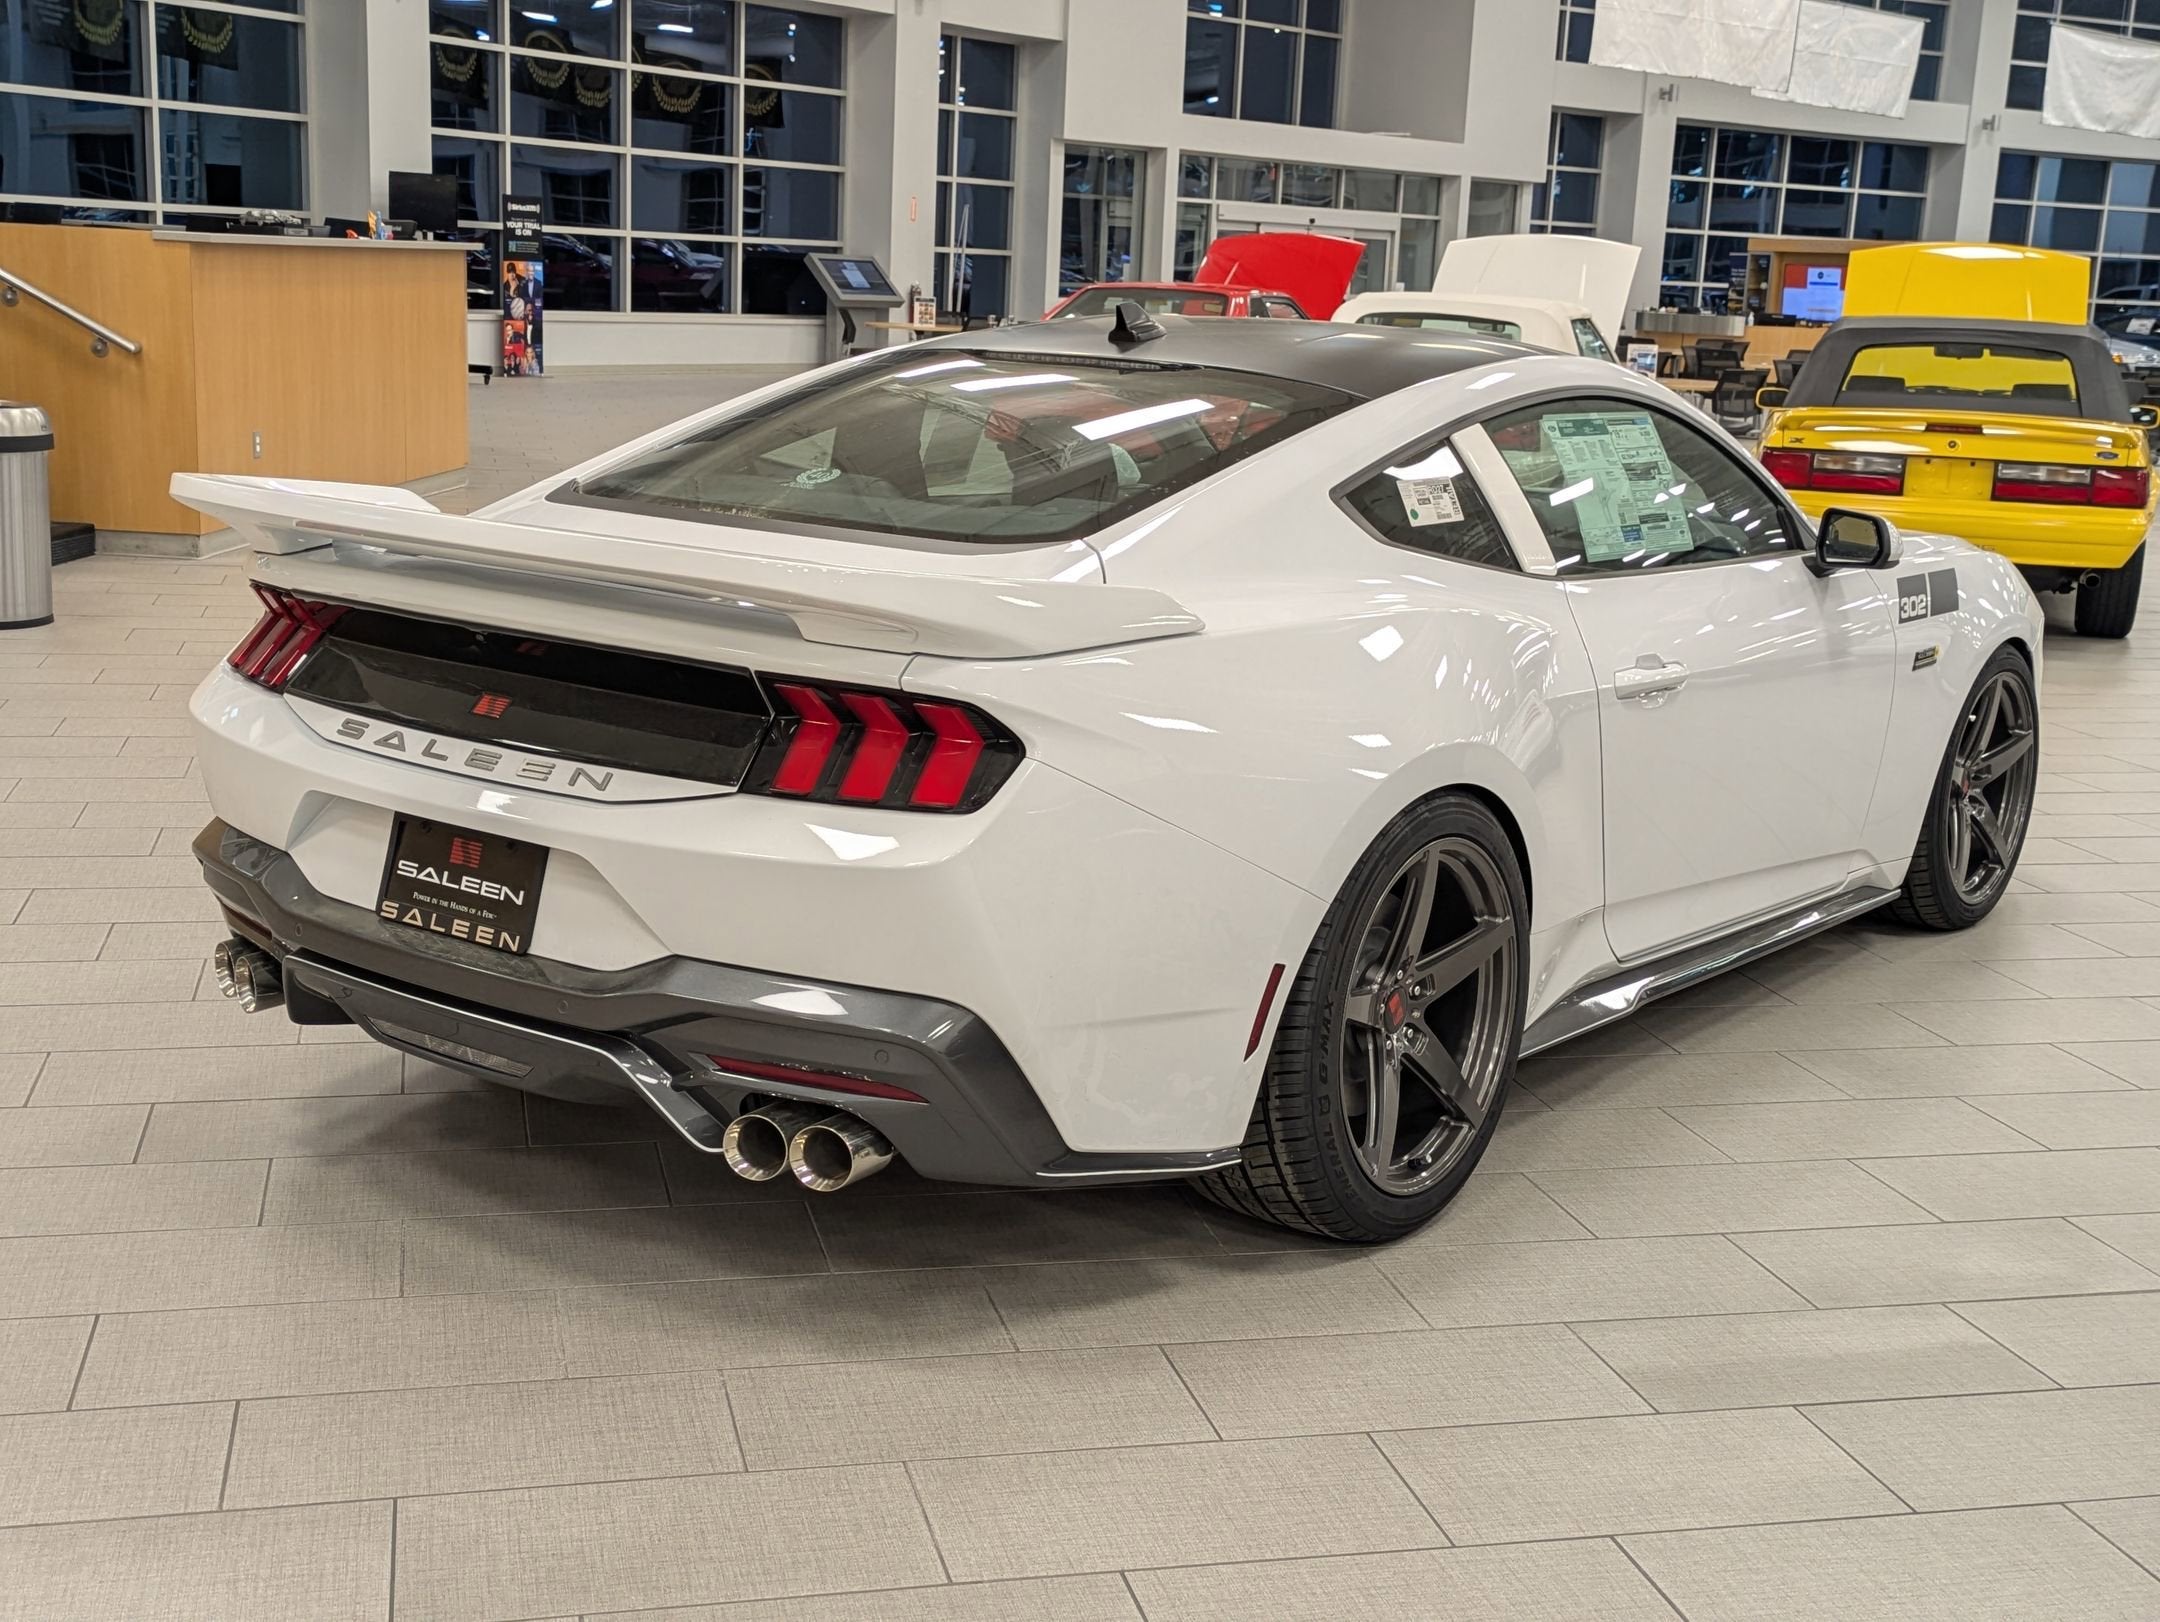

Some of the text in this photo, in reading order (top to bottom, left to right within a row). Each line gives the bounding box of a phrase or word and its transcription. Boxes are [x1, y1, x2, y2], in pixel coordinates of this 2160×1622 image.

[506, 221, 541, 230] YOUR TRIAL
[1900, 593, 1927, 619] 302
[336, 717, 614, 792] SALEEN
[396, 859, 525, 906] SALEEN
[380, 900, 520, 952] SALEEN
